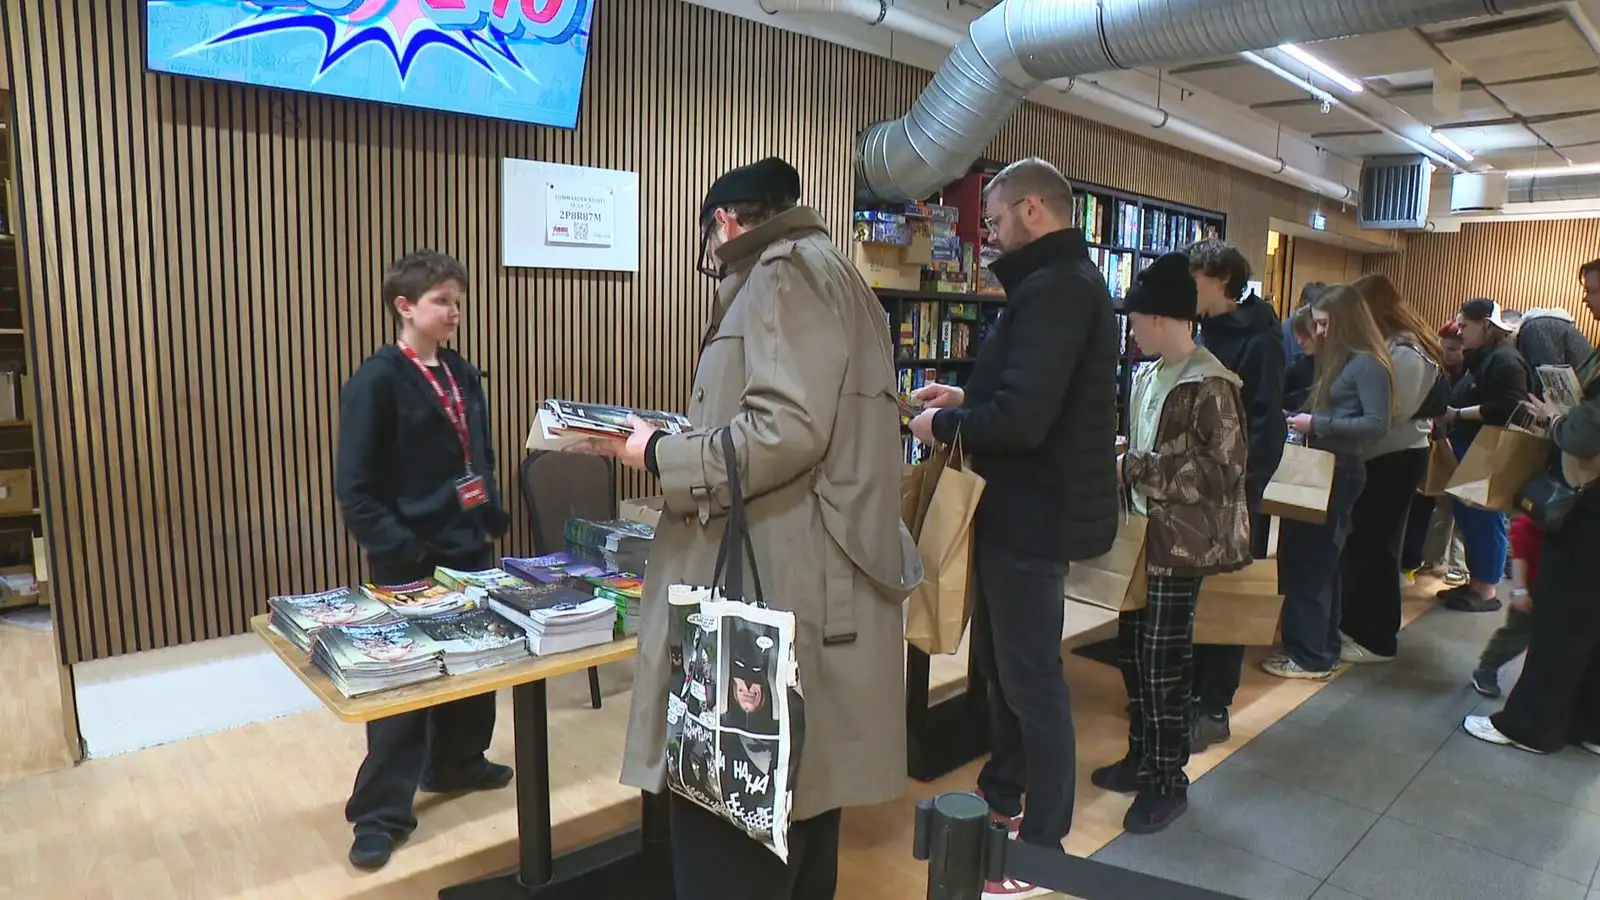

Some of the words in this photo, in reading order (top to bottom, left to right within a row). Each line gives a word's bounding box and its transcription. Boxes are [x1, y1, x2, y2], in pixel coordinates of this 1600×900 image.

[559, 210, 602, 222] 2P8R87M
[733, 760, 749, 782] HA
[745, 774, 770, 795] HA
